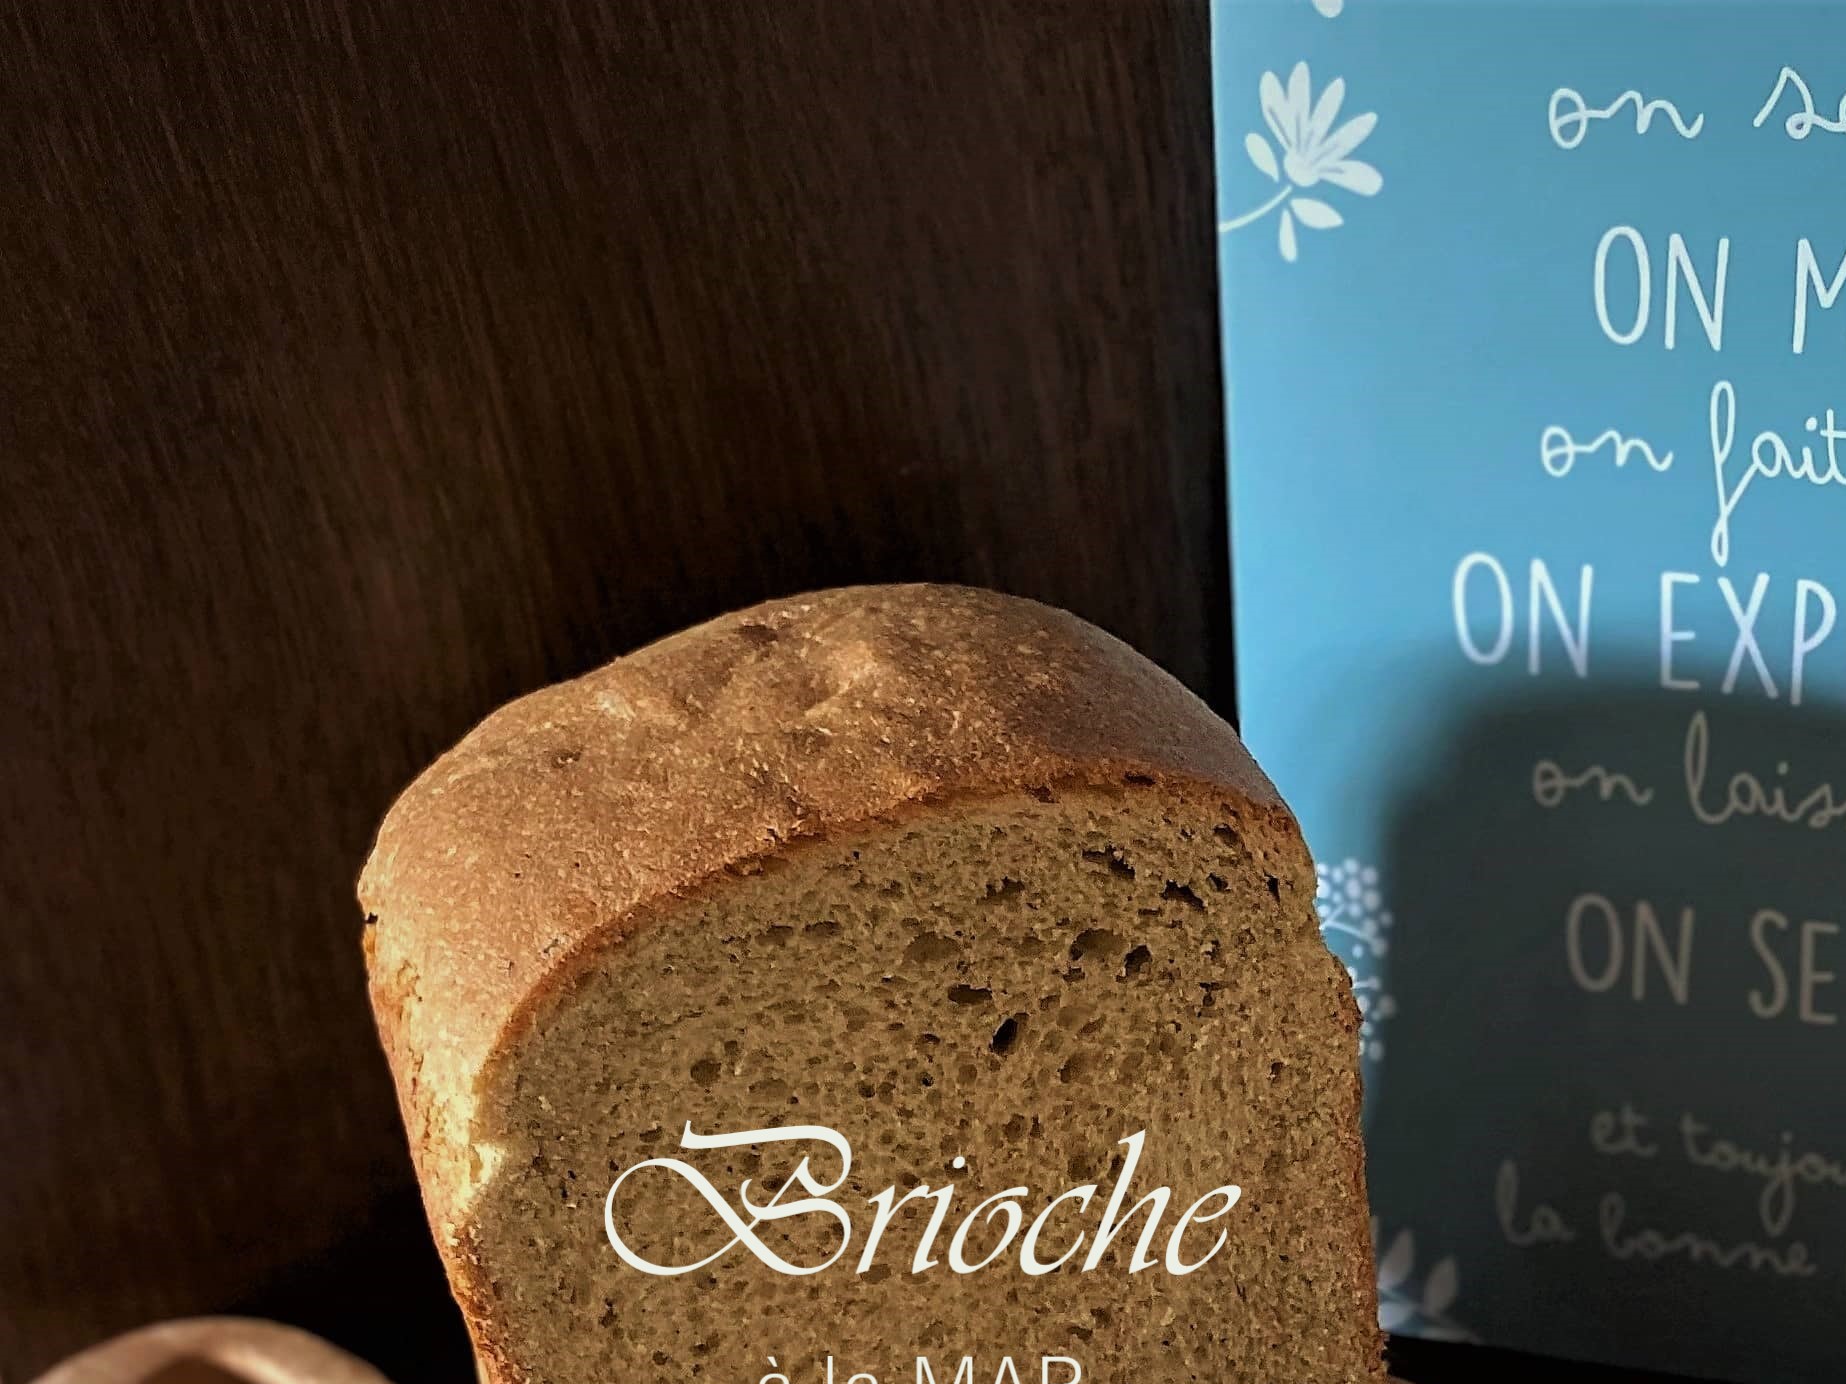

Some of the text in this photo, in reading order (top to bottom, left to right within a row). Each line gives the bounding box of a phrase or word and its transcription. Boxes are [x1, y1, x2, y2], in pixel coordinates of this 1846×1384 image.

[1548, 86, 1705, 150] on
[1593, 225, 1730, 352] ON
[1540, 425, 1674, 478] on
[1452, 551, 1594, 678] ON
[1532, 758, 1655, 808] on
[1565, 893, 1695, 1006] ON
[1747, 908, 1841, 1025] SE
[1590, 1103, 1660, 1158] et
[1495, 1158, 1578, 1249] la
[1601, 1190, 1818, 1277] bonne
